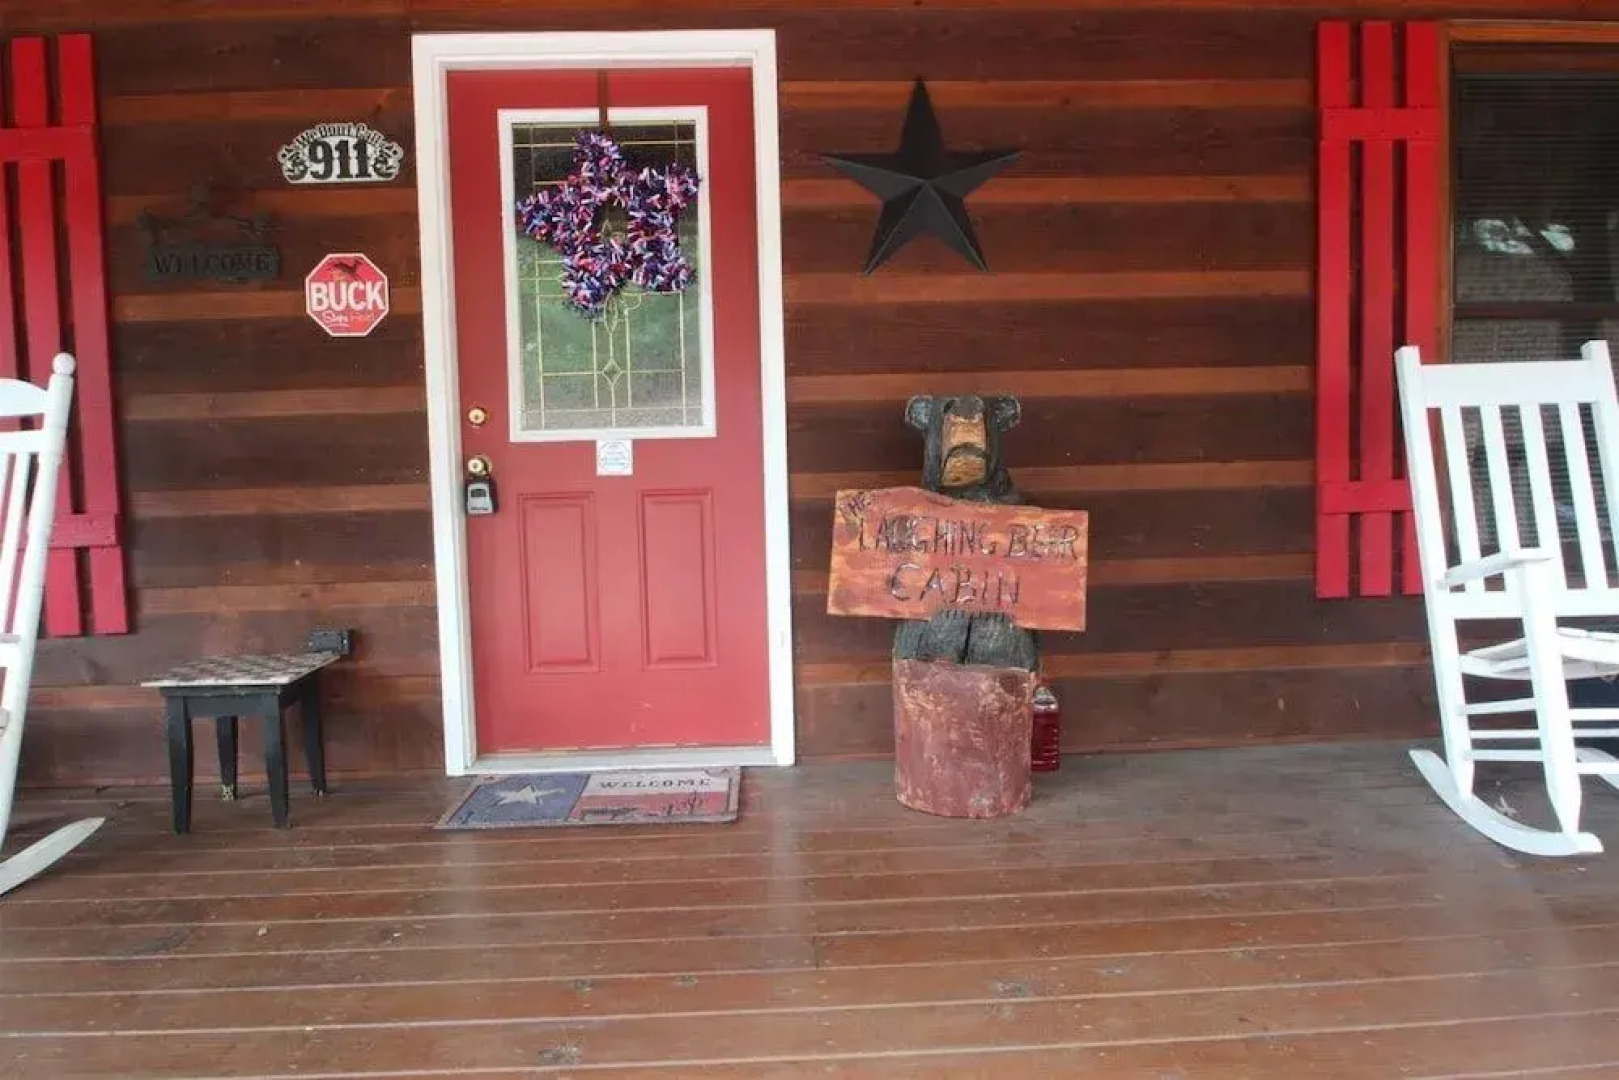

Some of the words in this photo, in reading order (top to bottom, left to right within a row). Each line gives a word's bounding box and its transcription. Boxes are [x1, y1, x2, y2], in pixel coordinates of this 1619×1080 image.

[308, 139, 372, 179] 911
[154, 251, 274, 273] WELCOME
[310, 280, 385, 312] BUCK
[858, 515, 997, 557] LAUGHING
[1003, 523, 1081, 561] BEAR
[889, 562, 1021, 606] CABIN
[599, 778, 711, 788] WELCOME
